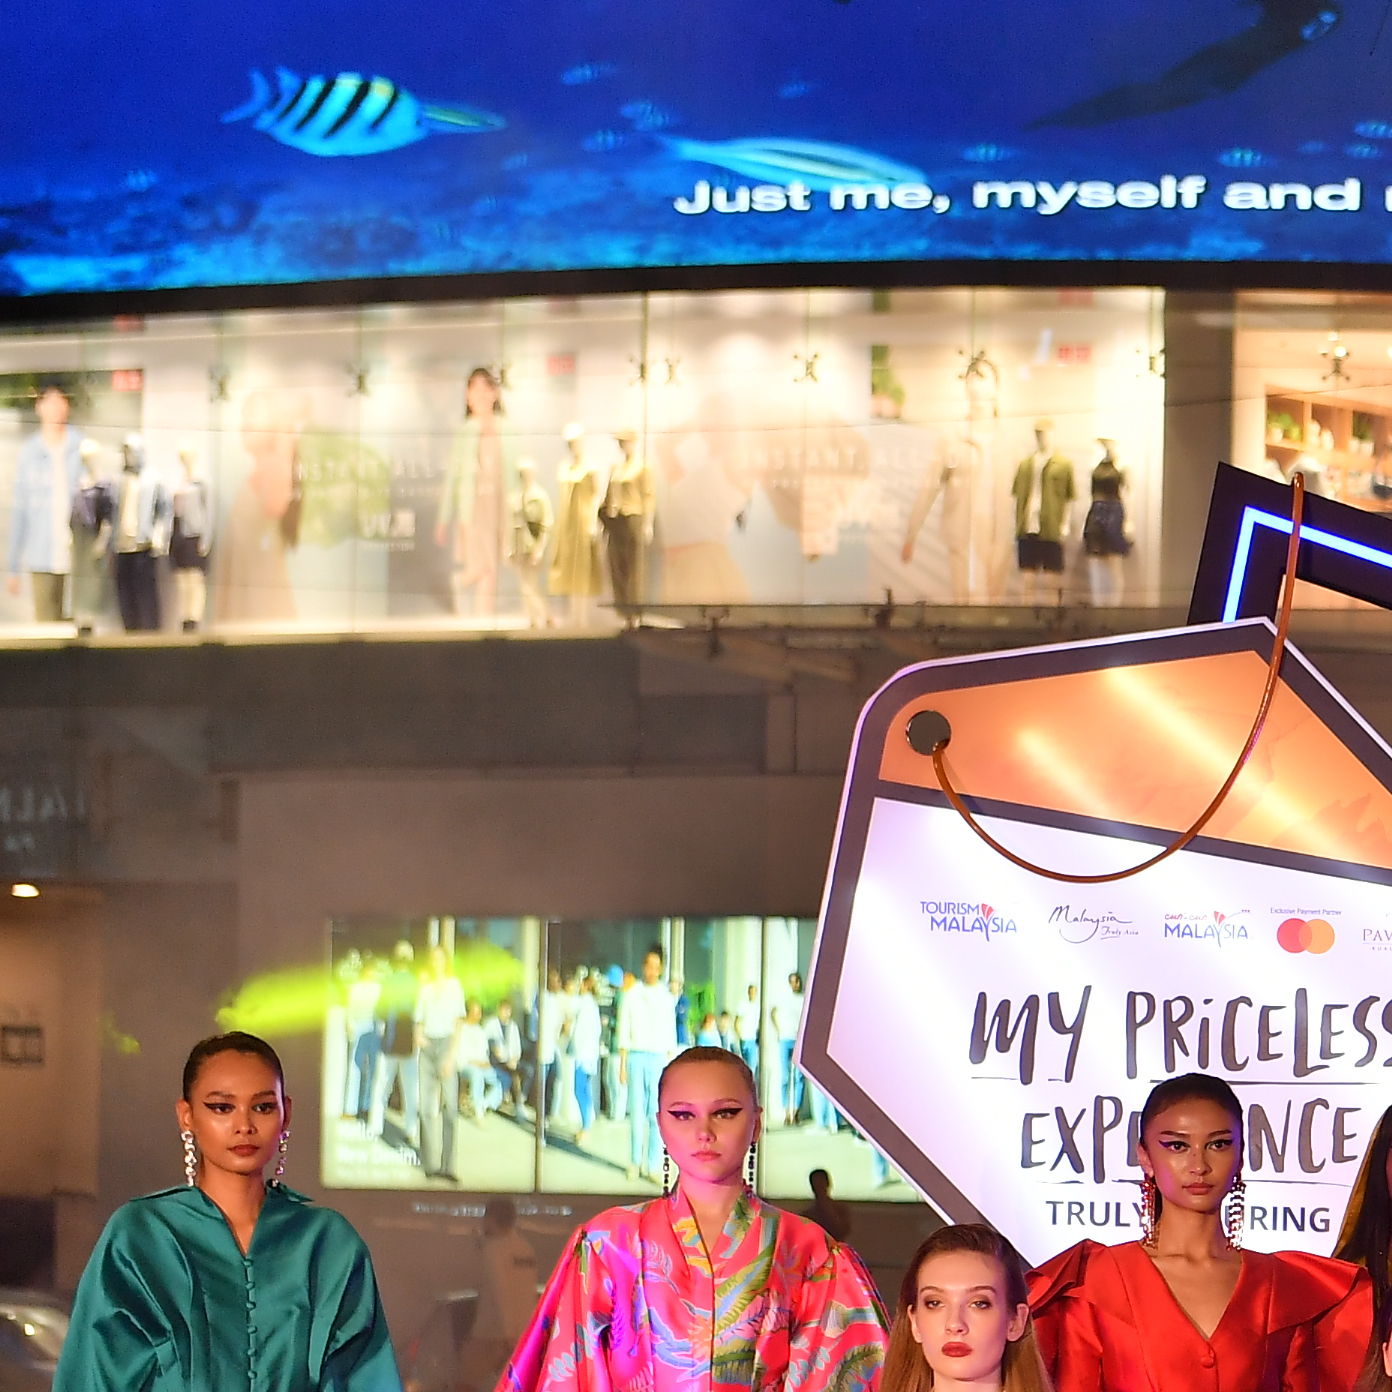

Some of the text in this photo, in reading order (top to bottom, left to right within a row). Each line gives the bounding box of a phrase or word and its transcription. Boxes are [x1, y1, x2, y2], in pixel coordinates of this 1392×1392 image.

[673, 179, 812, 216] Just
[830, 176, 950, 217] me,
[972, 172, 1206, 215] myself
[1223, 176, 1362, 214] and
[920, 901, 980, 916] TOURISM
[1048, 904, 1134, 944] Malaysia
[1270, 907, 1343, 917] Exclusive Payment Partner
[930, 915, 1017, 942] MALAYSIA
[1163, 922, 1250, 948] MALAYSIA
[969, 985, 1093, 1086] MY
[1021, 1095, 1363, 1184] EXPENCE
